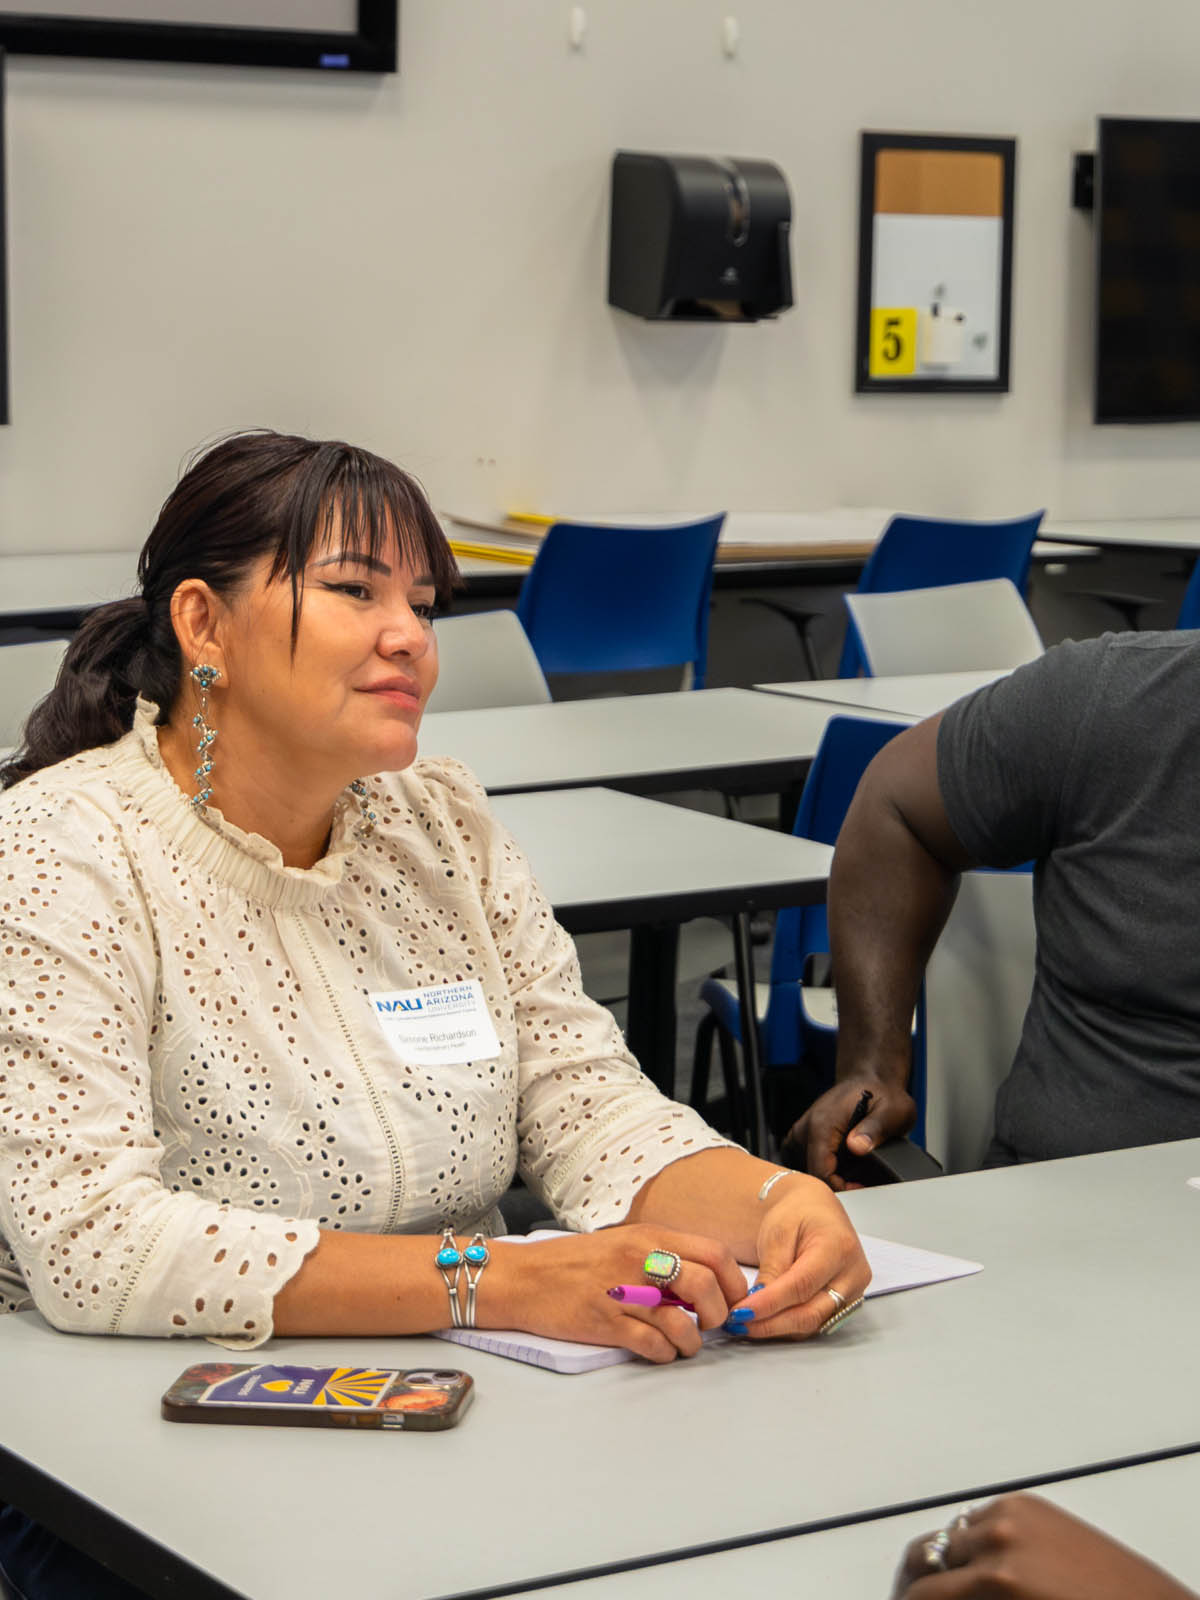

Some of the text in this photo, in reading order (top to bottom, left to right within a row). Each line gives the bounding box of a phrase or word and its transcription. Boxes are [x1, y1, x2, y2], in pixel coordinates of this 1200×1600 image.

[883, 318, 902, 362] 5
[424, 985, 473, 998] NORTHERN
[376, 998, 423, 1012] NAU
[426, 992, 474, 1006] ARIZONA
[429, 1029, 477, 1042] Richardson
